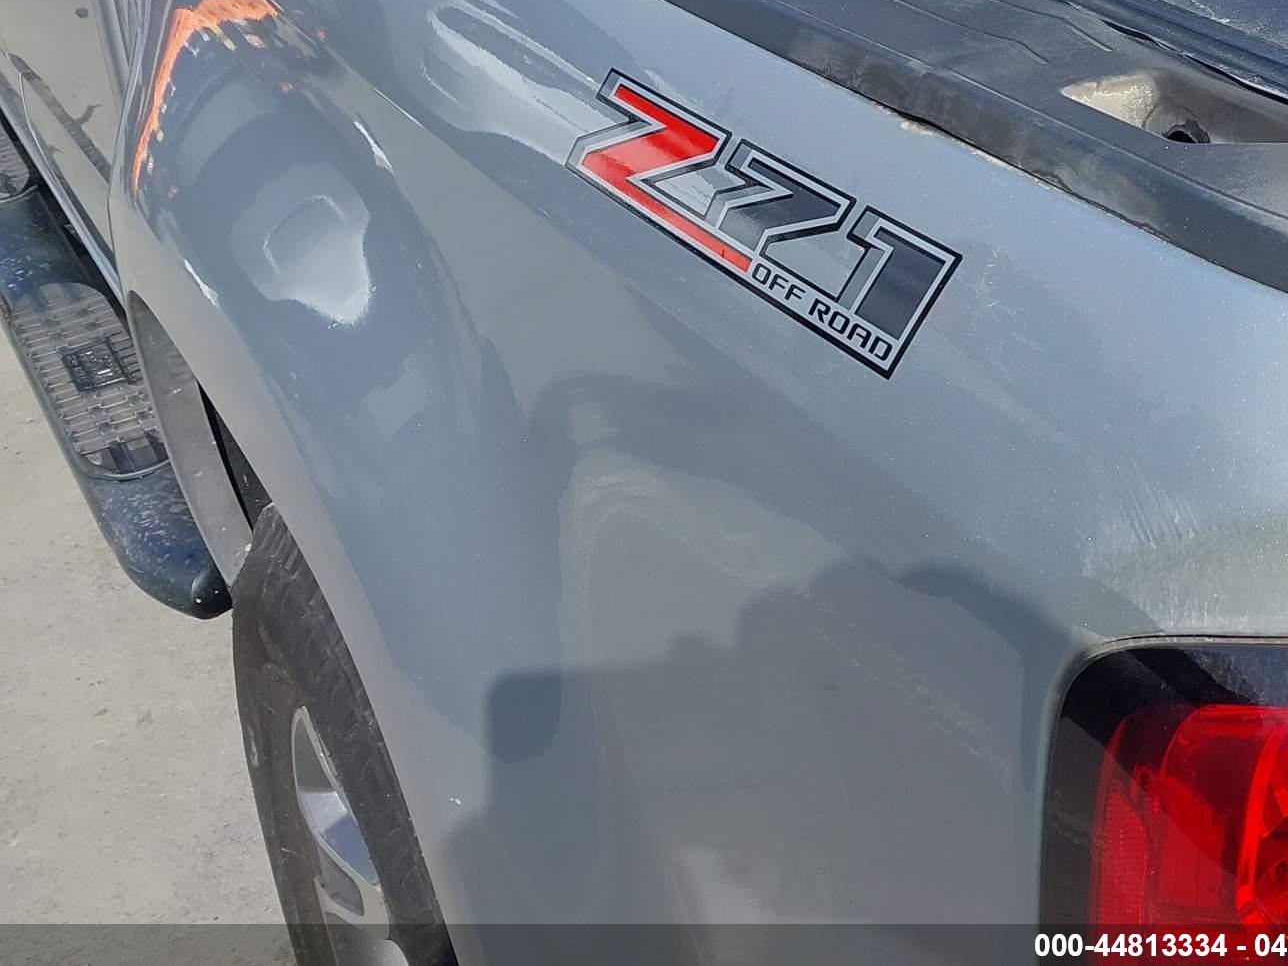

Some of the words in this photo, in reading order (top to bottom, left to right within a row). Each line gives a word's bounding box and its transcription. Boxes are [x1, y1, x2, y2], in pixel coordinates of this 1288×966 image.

[567, 69, 961, 346] Z71
[751, 262, 807, 301] OFF
[807, 297, 893, 362] ROAD
